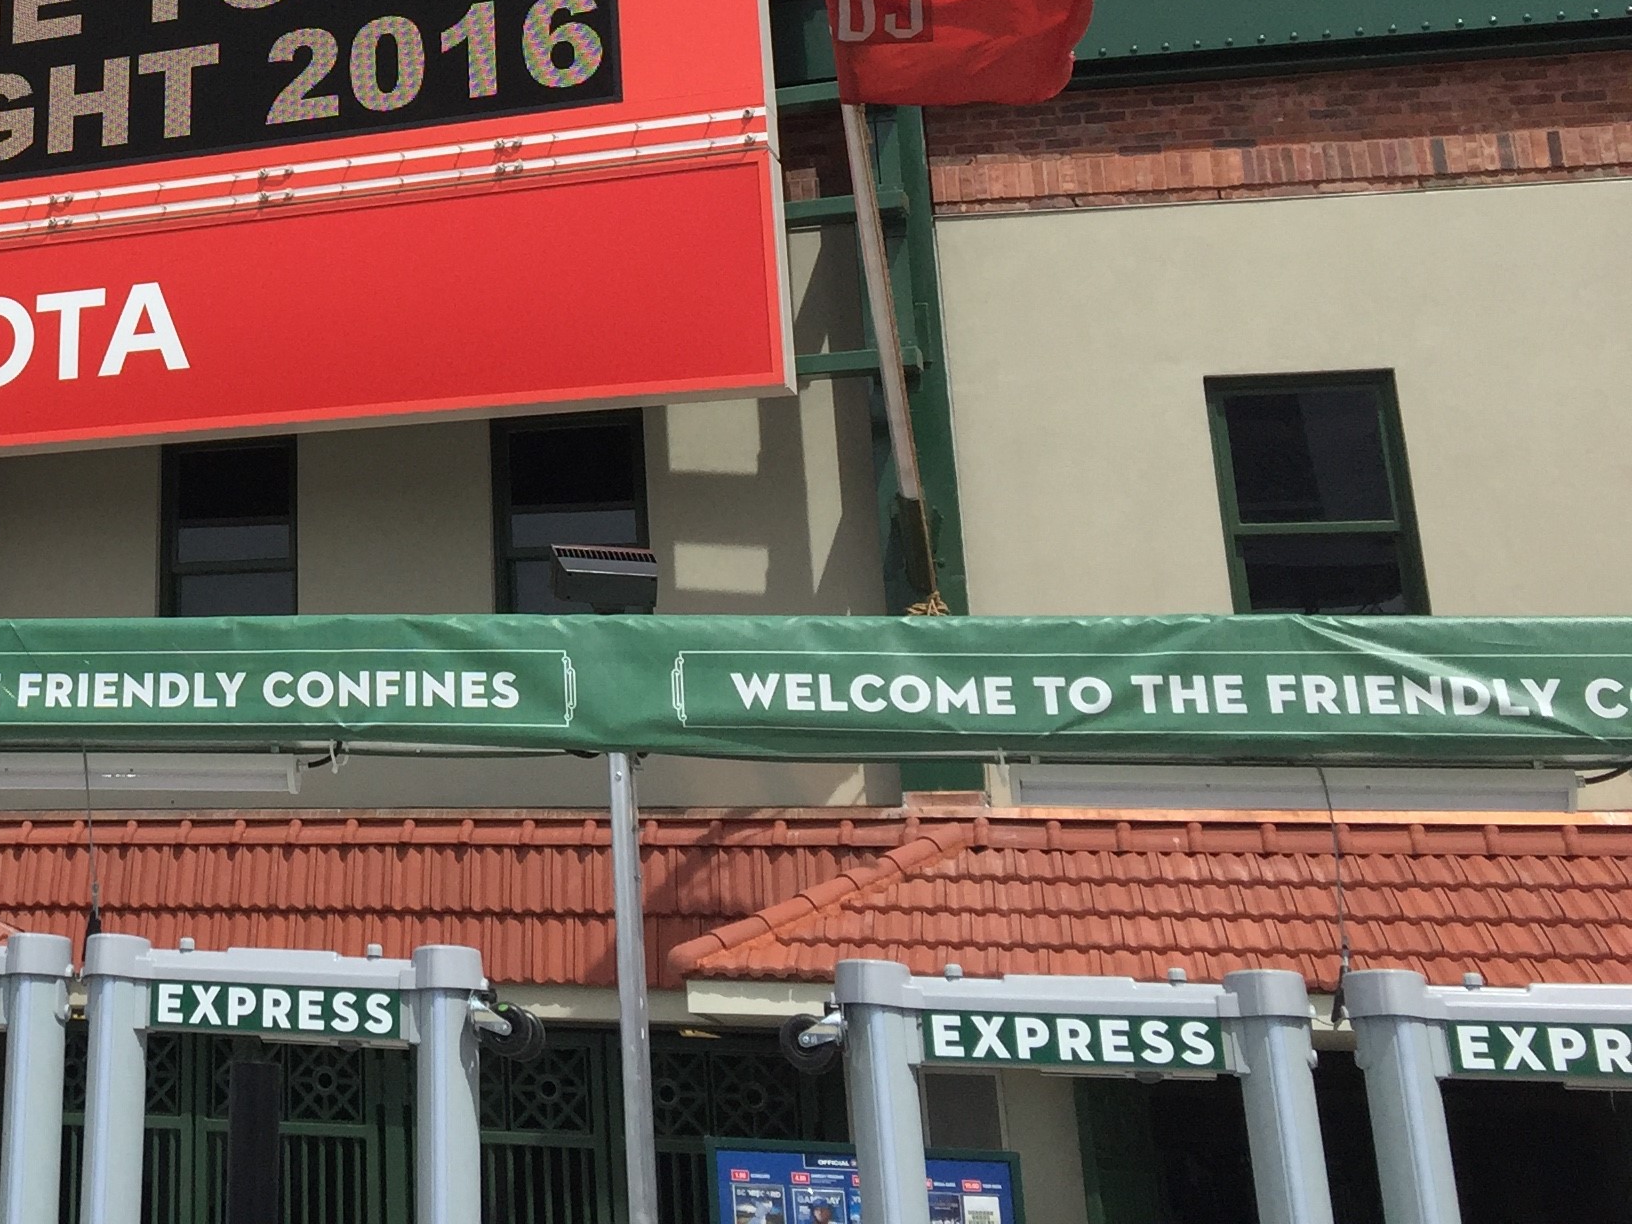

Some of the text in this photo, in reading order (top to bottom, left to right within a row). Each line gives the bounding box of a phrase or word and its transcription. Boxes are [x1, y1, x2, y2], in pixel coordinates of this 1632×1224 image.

[17, 671, 247, 708] FRIENDLY
[262, 669, 520, 708] CONFINES
[729, 672, 1017, 716] WELCOME
[1033, 676, 1113, 716] TO
[1130, 674, 1248, 715] THE
[1266, 674, 1561, 718] FRIENDLY
[157, 982, 394, 1036] EXPRESS
[931, 1014, 1216, 1067] EXPRESS
[1456, 1024, 1632, 1074] EXPR
